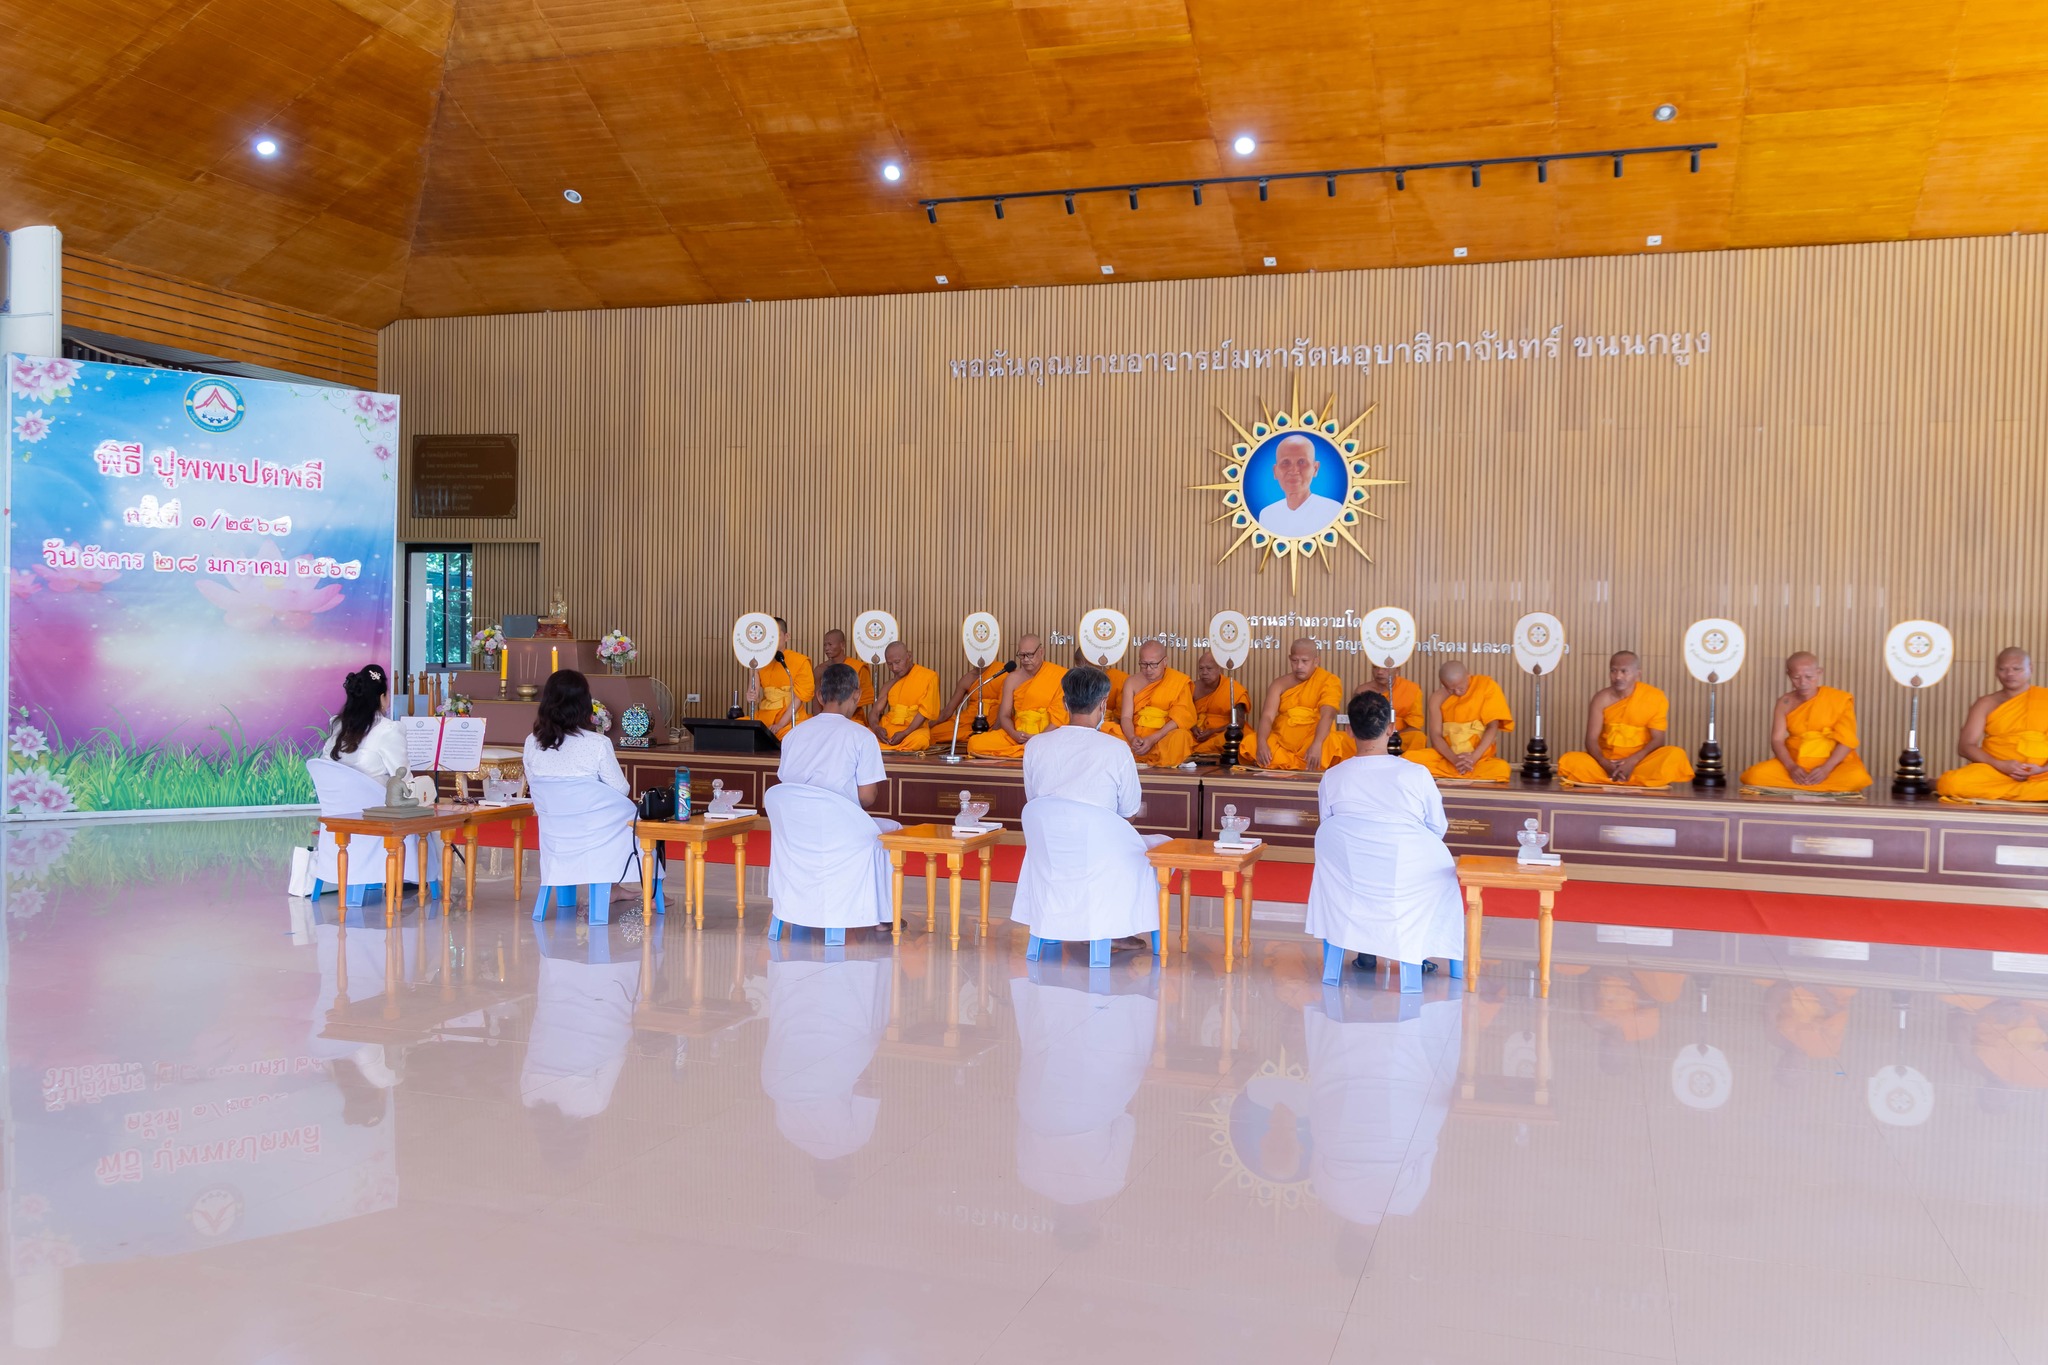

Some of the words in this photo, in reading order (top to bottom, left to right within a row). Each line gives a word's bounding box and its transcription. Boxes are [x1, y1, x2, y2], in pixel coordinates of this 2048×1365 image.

[949, 325, 1563, 386] หอฉันคุณยายอาจารย์มหารัตนอุบาสิกาจันทร์
[1574, 331, 1711, 366] ขนนกยูง
[97, 444, 141, 474] พิธี
[153, 451, 323, 489] ปุพพเปตพลี
[156, 554, 198, 571] ๒๘
[208, 559, 287, 576] มกราคม
[297, 560, 358, 577] ๒๕๖๘
